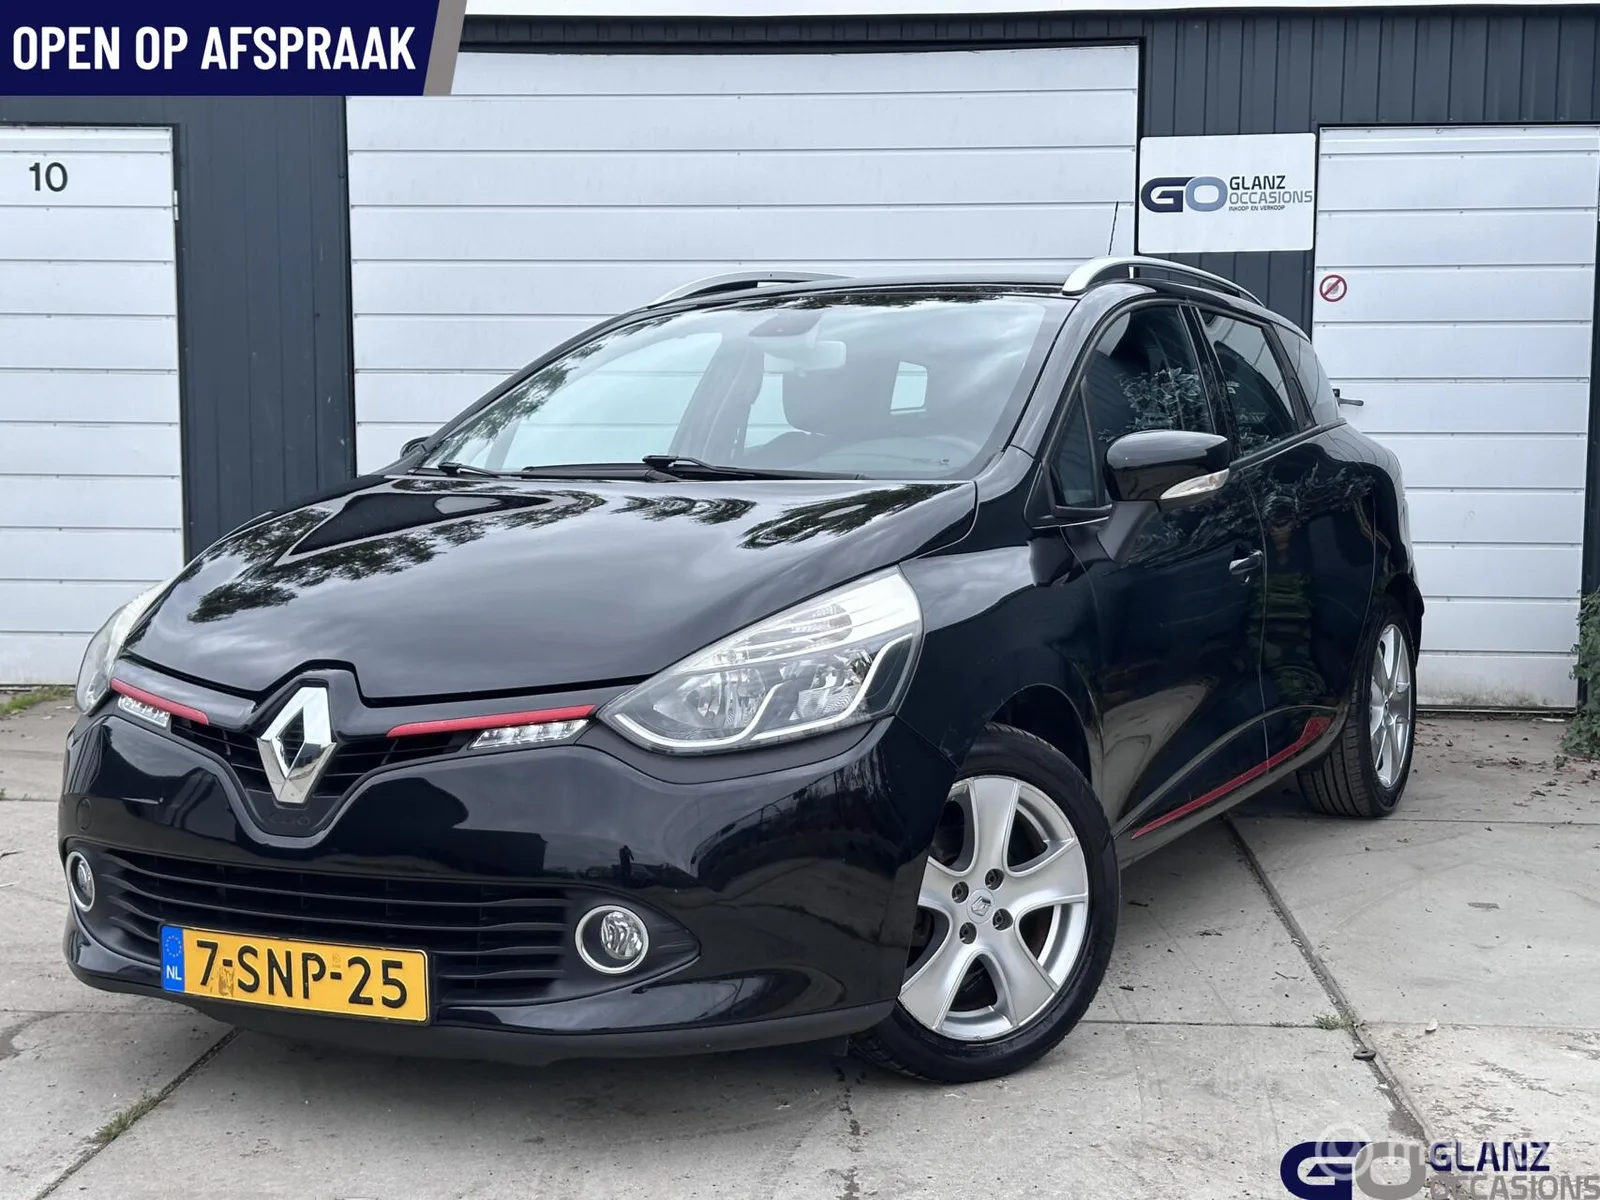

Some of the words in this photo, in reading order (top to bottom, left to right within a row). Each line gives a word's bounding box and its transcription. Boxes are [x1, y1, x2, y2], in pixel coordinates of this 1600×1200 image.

[28, 162, 68, 192] 10
[1229, 175, 1286, 190] GLANZ
[1140, 176, 1228, 213] GO
[1229, 190, 1313, 205] OCCASIONS
[166, 965, 182, 981] NL
[196, 939, 408, 1008] 7-SNP-25
